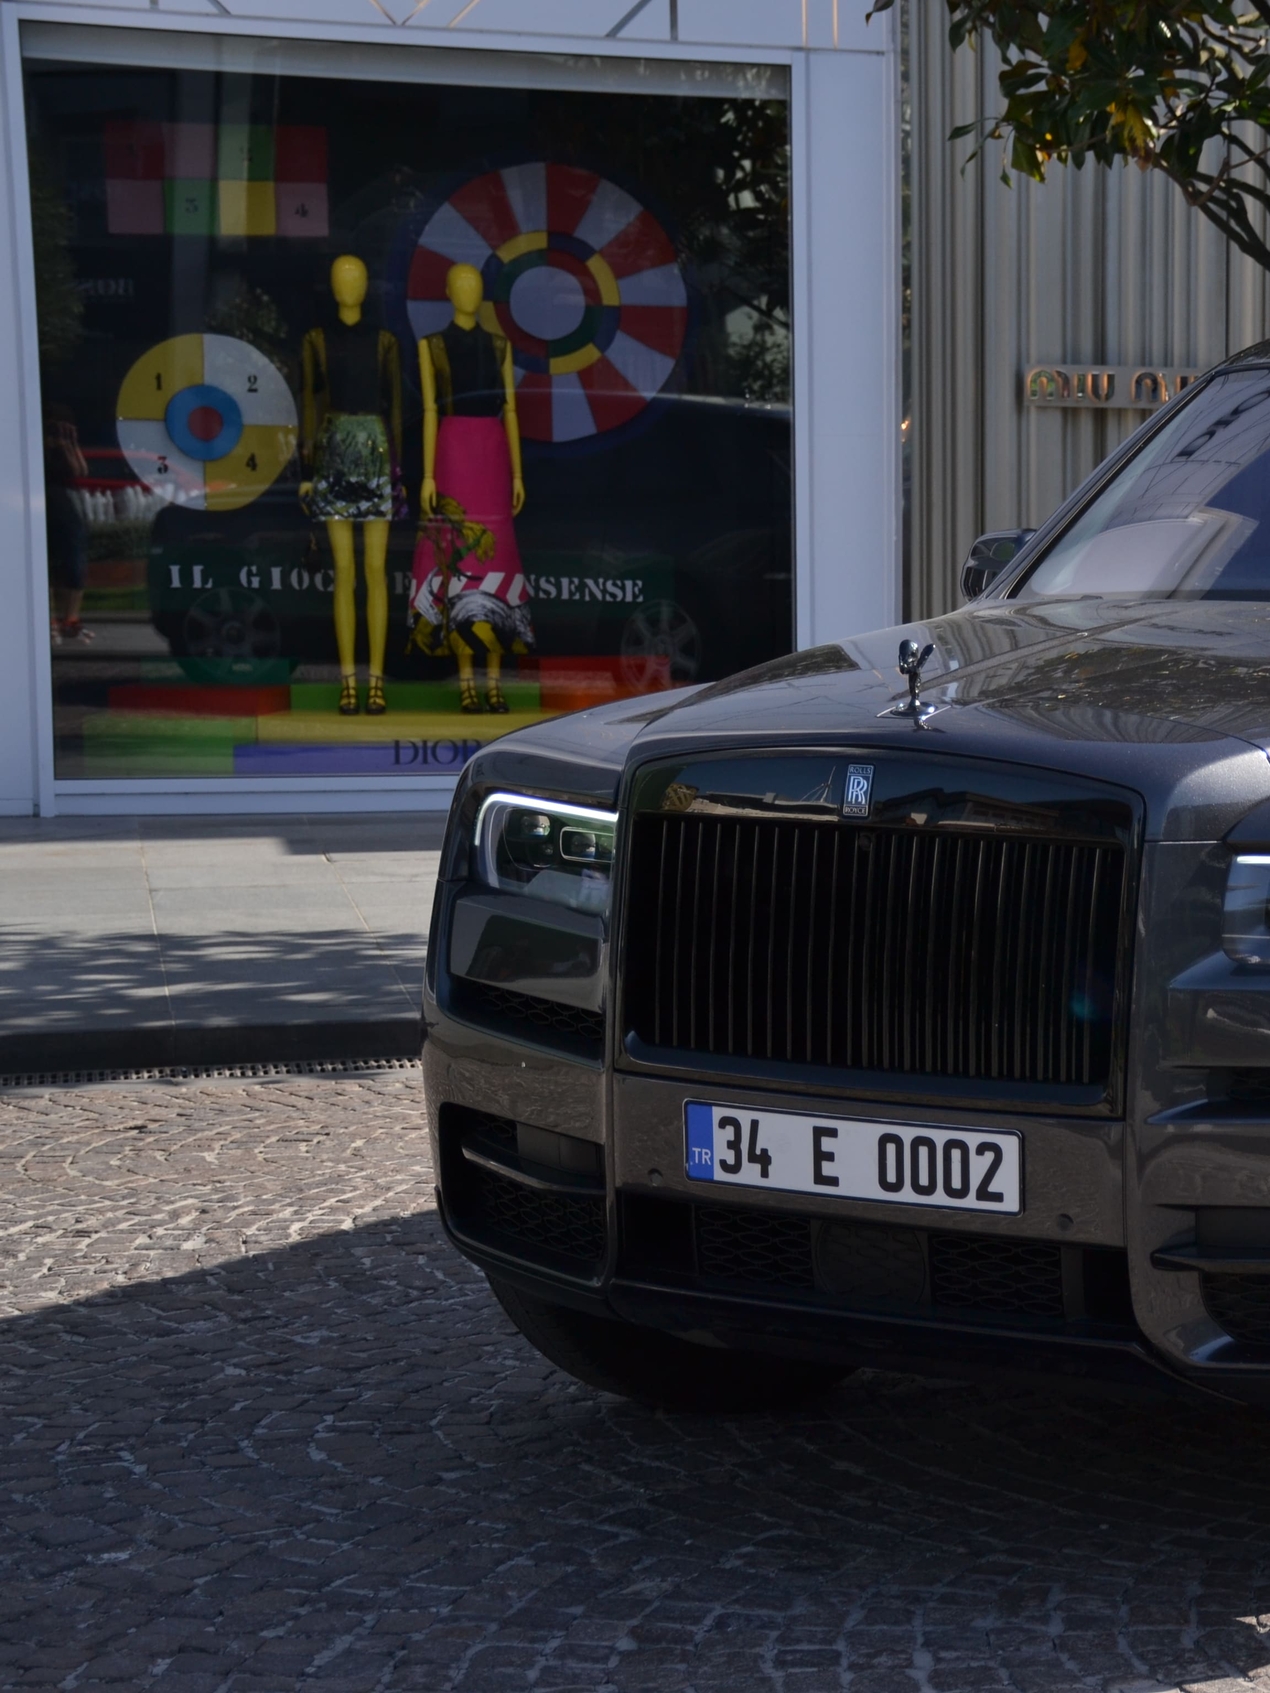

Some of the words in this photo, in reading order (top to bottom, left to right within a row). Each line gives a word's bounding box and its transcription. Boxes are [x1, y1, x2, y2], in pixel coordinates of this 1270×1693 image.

[154, 373, 164, 391] 1
[246, 374, 259, 393] 2
[1028, 369, 1116, 402] MIU
[1132, 372, 1199, 402] MI
[157, 455, 169, 474] 3
[246, 453, 258, 472] 4
[168, 564, 213, 589] IL
[239, 565, 357, 593] GIOC
[849, 766, 871, 774] ROLLS
[844, 806, 866, 815] ROYCE
[692, 1147, 712, 1165] TR
[718, 1115, 772, 1179] 34
[812, 1125, 840, 1187] E
[877, 1132, 1005, 1203] 0002
